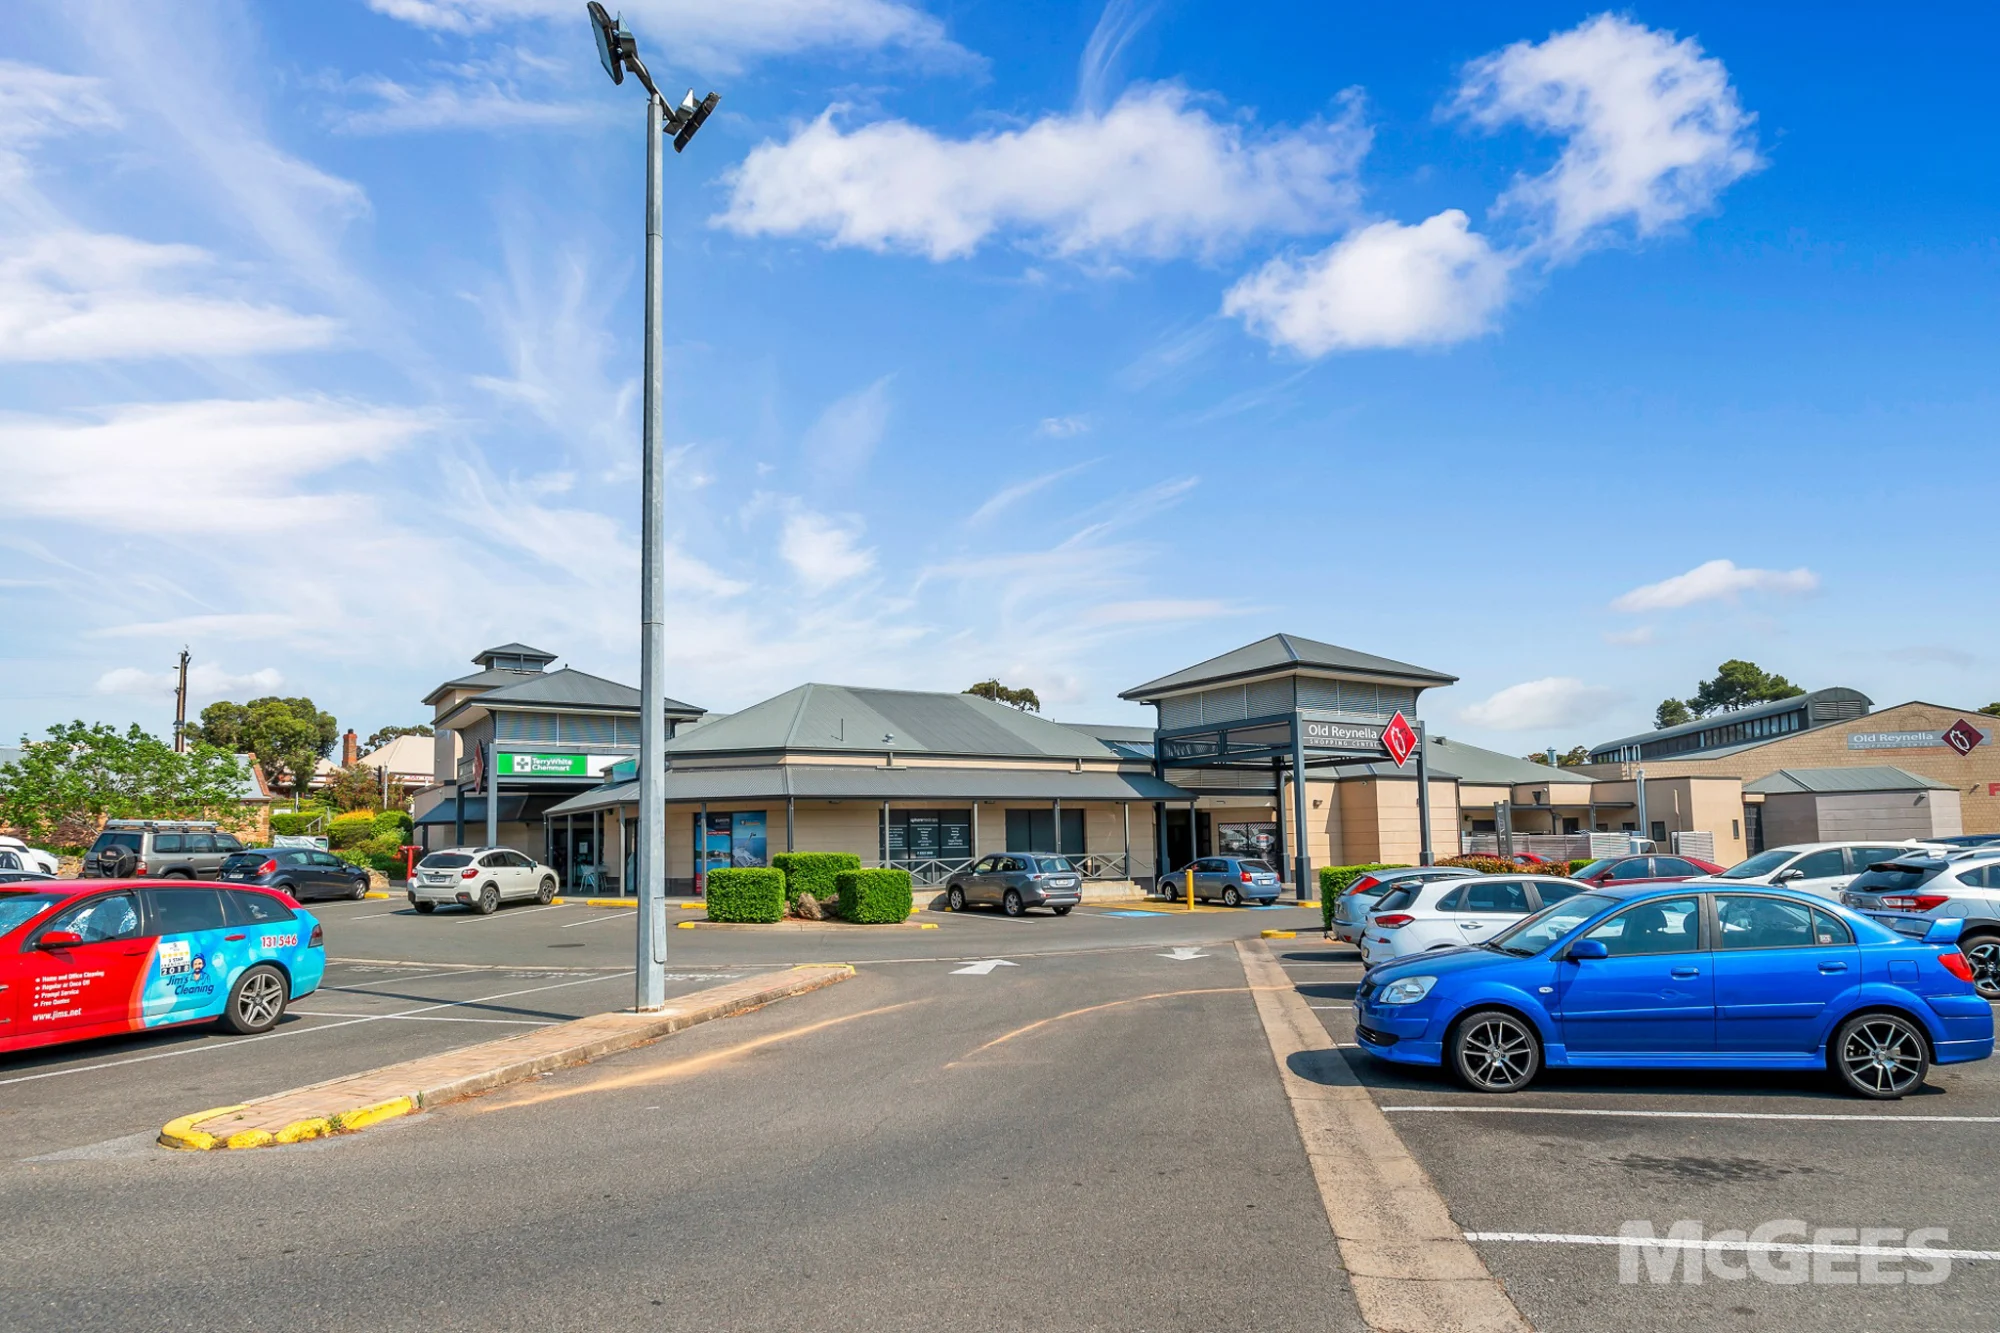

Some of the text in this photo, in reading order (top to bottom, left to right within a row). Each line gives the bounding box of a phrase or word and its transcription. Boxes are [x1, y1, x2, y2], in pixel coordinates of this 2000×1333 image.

[1308, 724, 1377, 739] Old Reynella
[1853, 733, 1934, 742] Old Reynella
[1309, 739, 1379, 748] SHOPPING CENTRE
[531, 757, 573, 766] TerryWhite
[162, 965, 189, 975] 2018
[83, 971, 105, 979] Cleaning
[166, 975, 188, 986] Jim's
[174, 984, 214, 995] Cleaning
[41, 991, 60, 999] Prompt
[32, 1008, 82, 1021] www.jims.net
